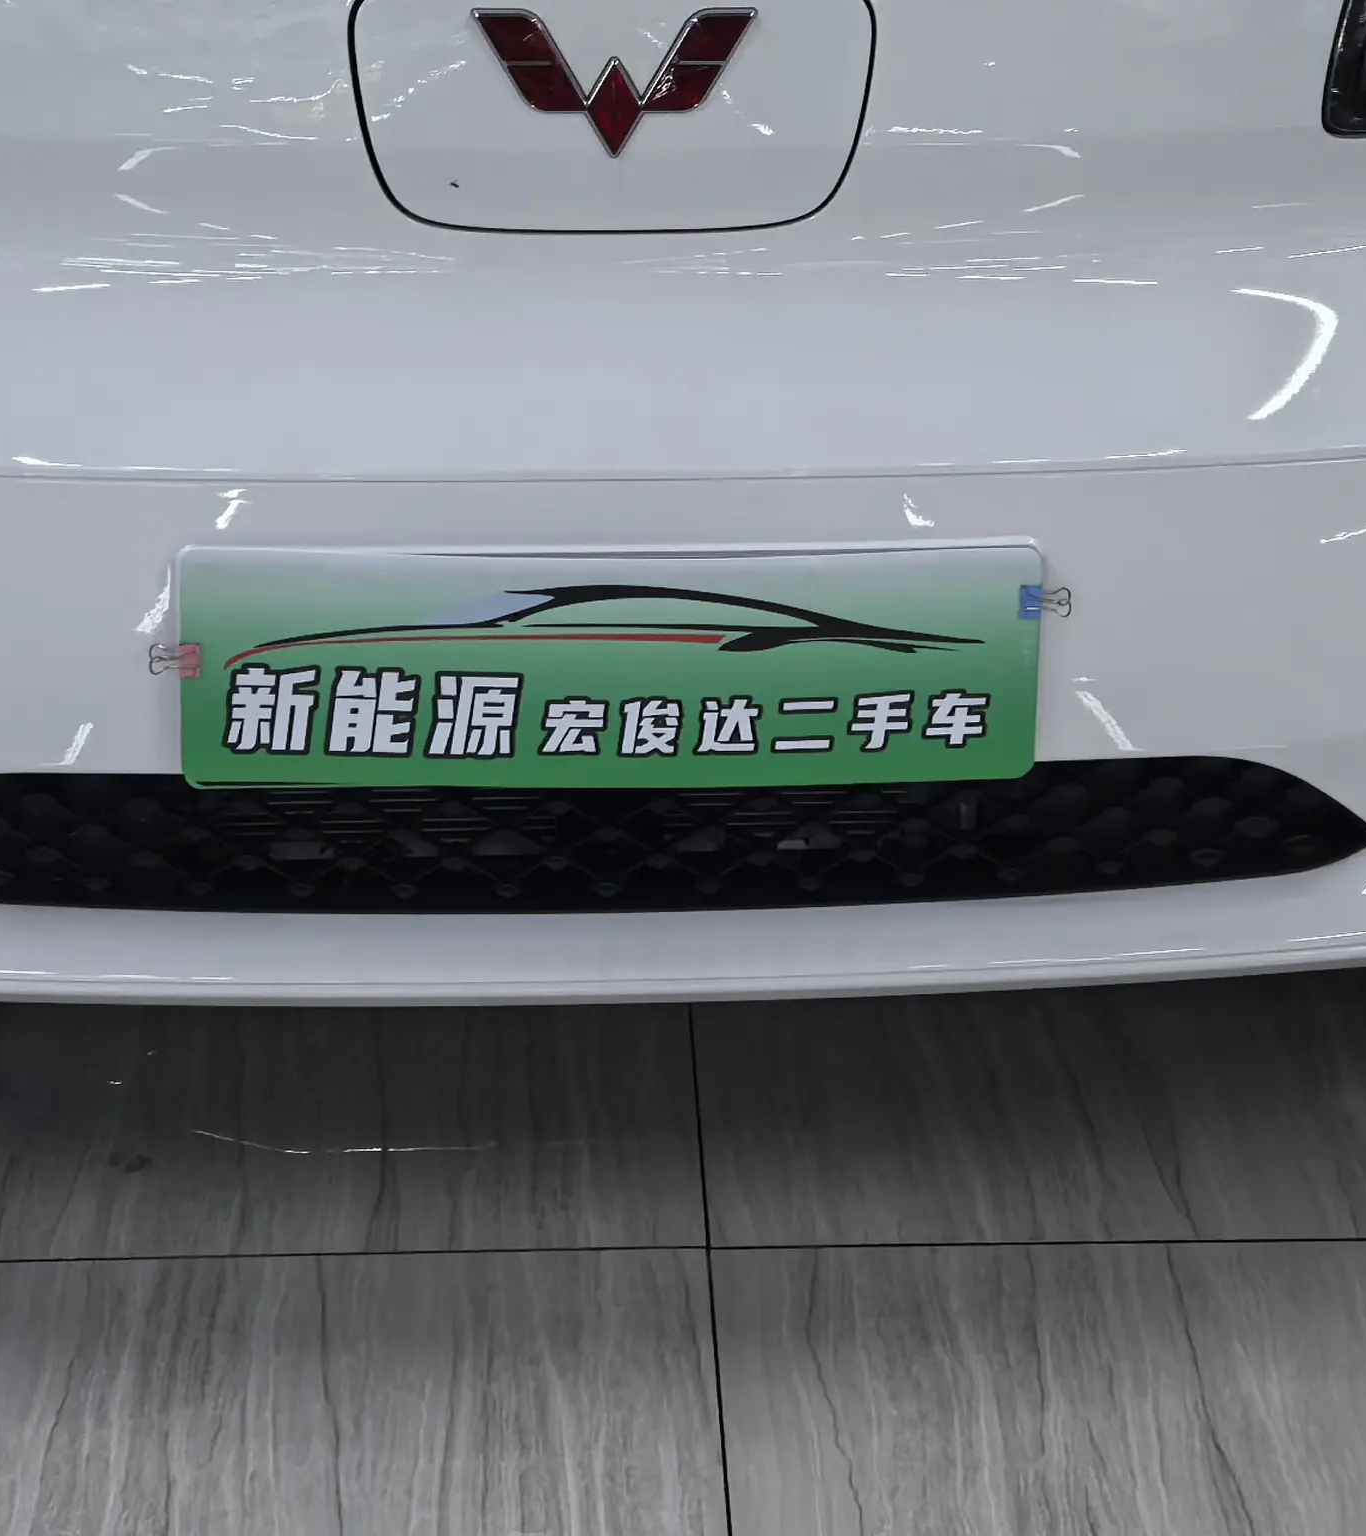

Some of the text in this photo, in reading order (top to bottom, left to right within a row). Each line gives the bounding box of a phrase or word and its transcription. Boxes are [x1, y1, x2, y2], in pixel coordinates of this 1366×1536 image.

[225, 664, 992, 761] 新能源 宏俊达二手车
